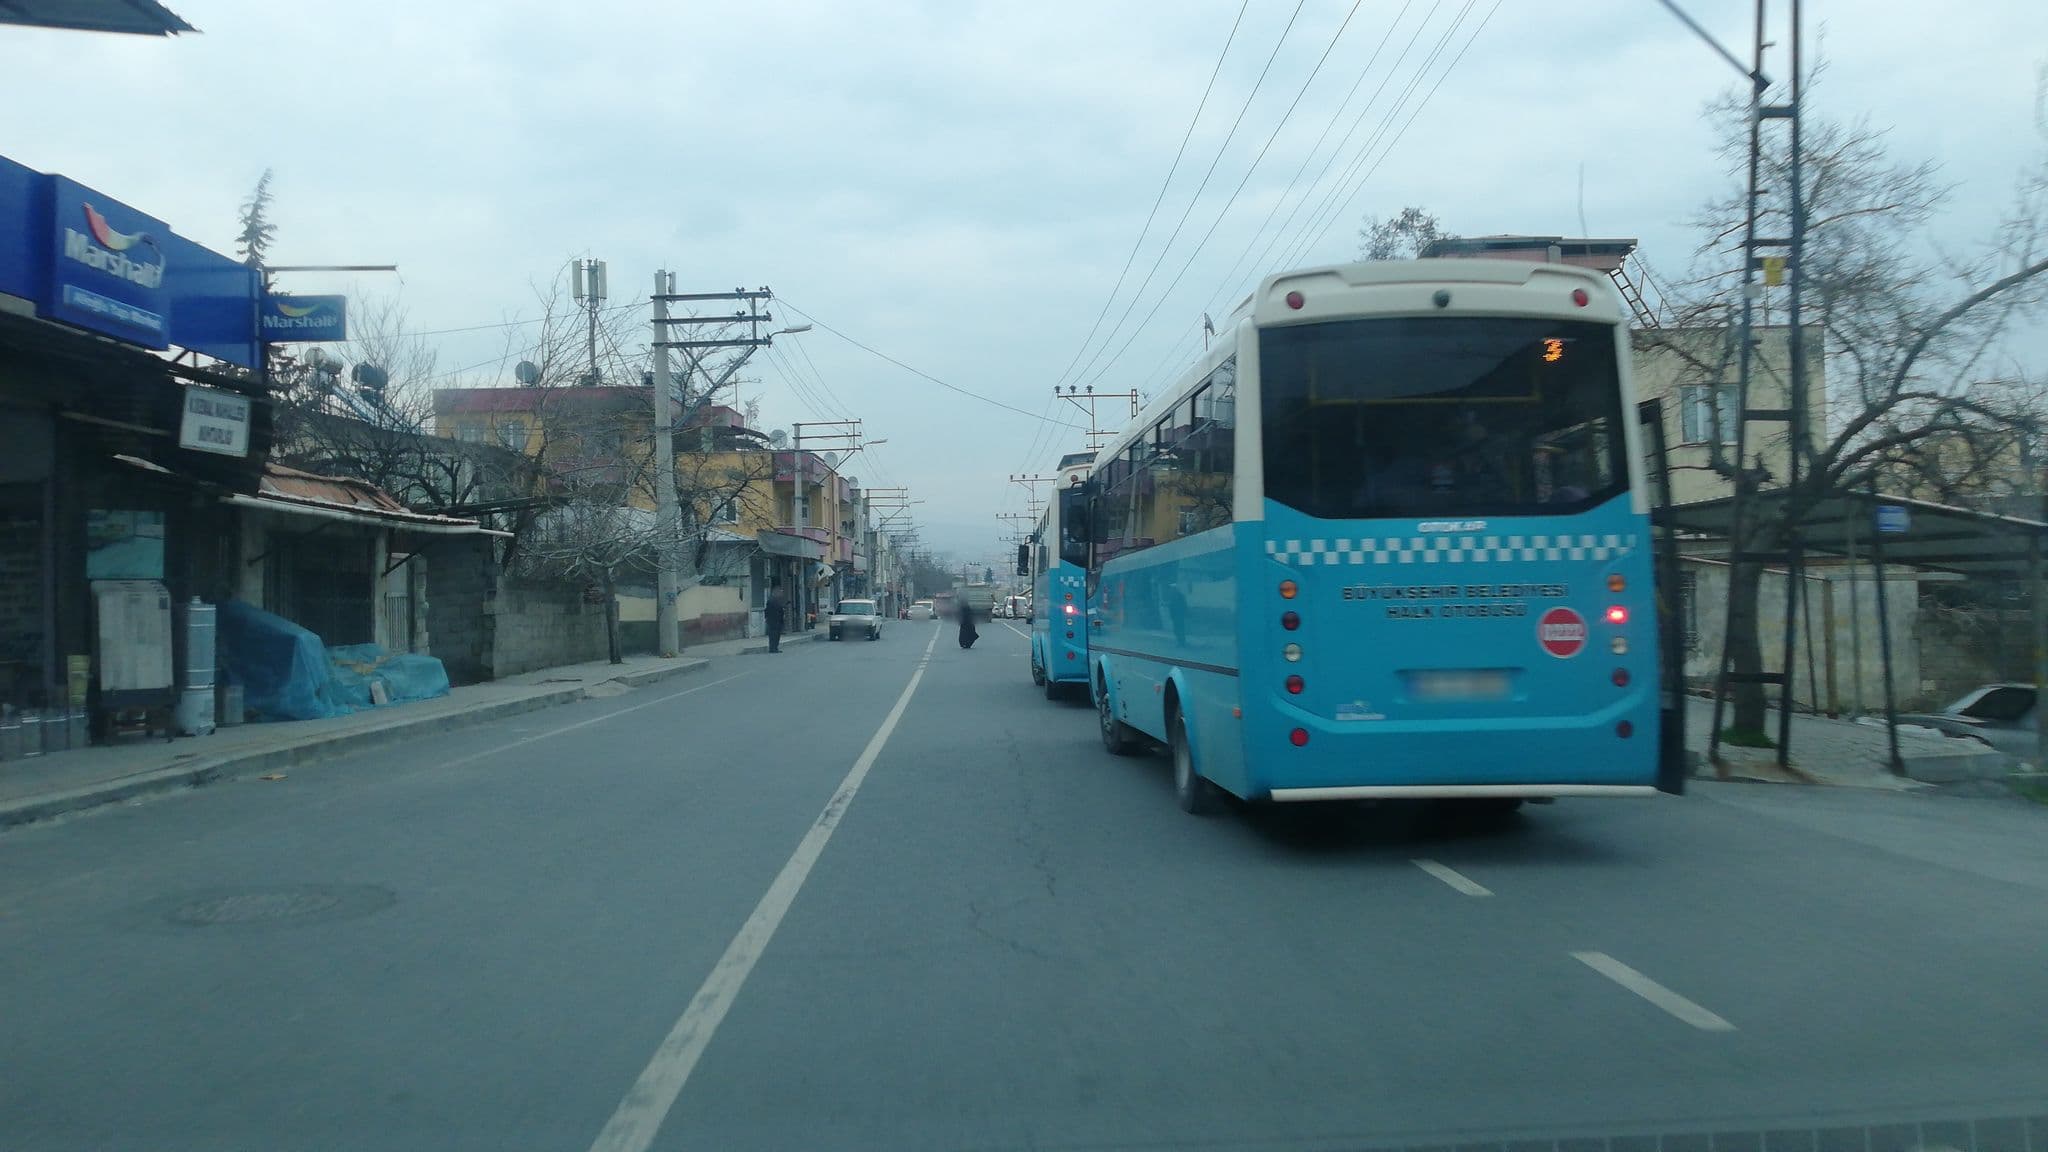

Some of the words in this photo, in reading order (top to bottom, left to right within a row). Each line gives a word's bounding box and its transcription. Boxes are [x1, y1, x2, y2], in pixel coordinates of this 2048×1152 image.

[64, 227, 161, 288] Marshall
[263, 315, 337, 328] Marshall
[1543, 338, 1562, 361] 3
[1386, 604, 1434, 618] HALK
